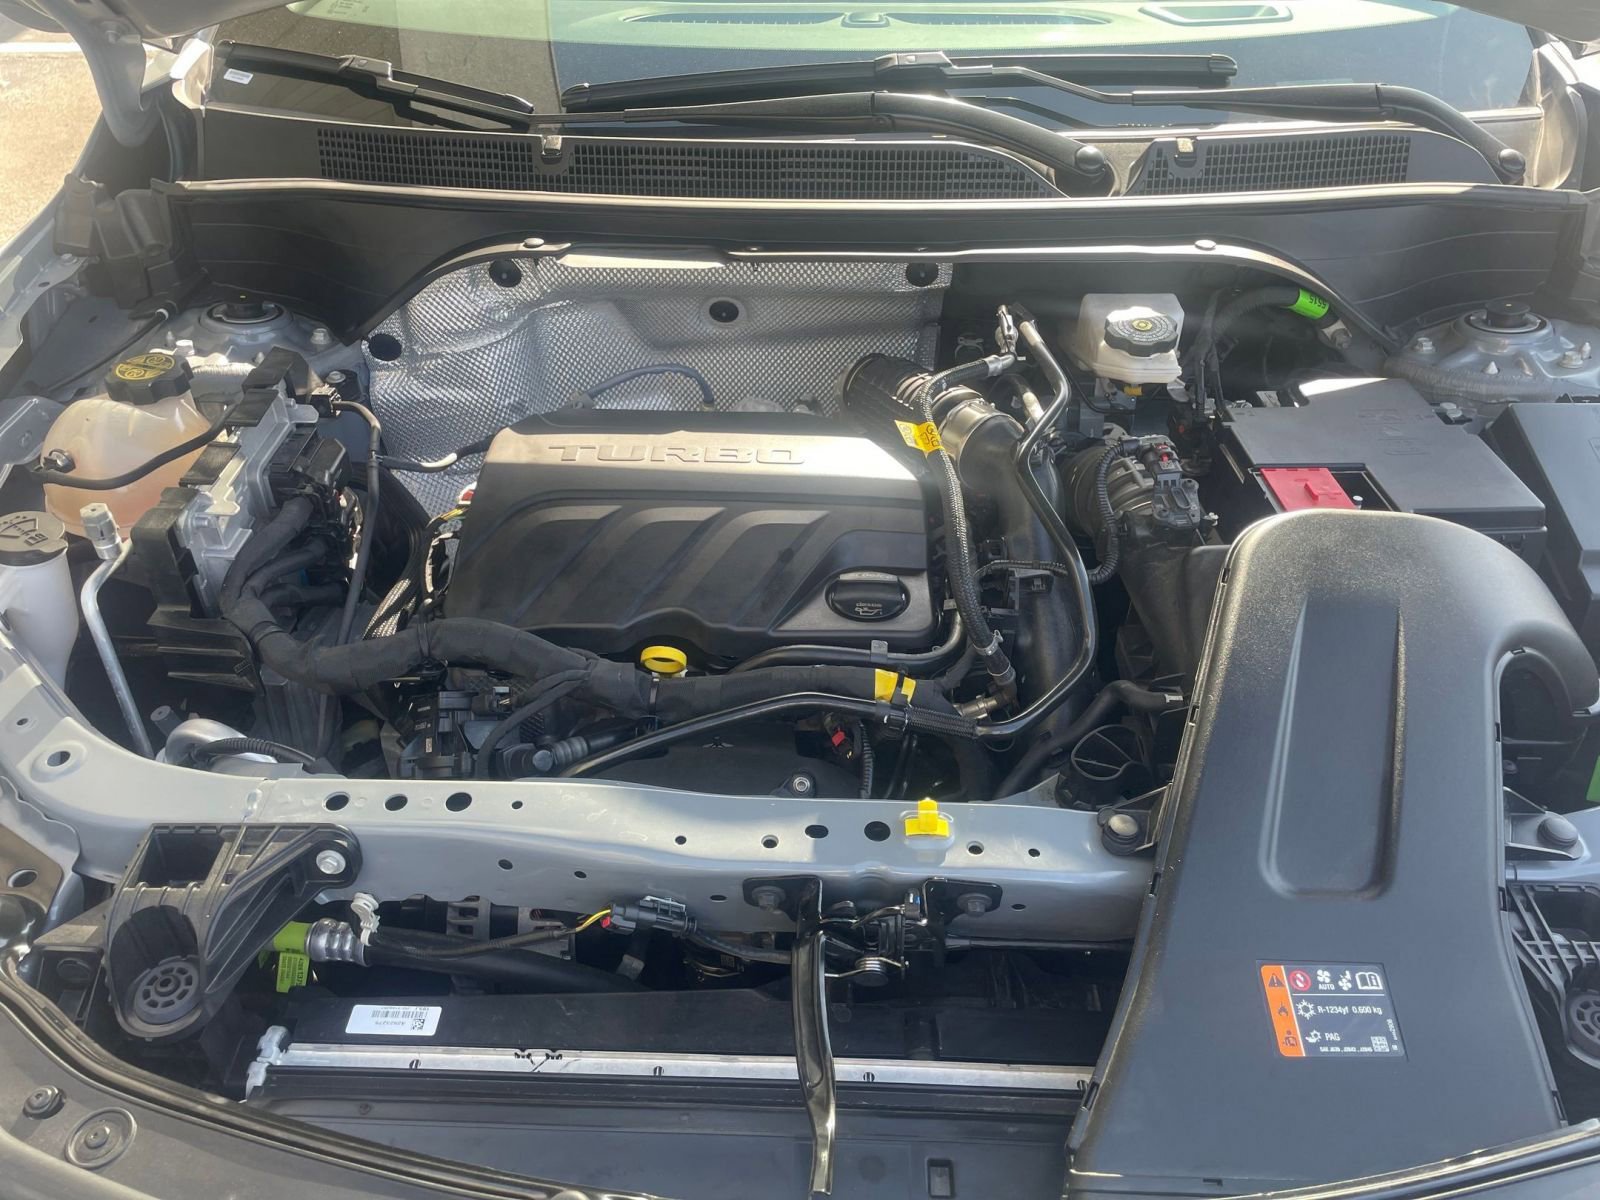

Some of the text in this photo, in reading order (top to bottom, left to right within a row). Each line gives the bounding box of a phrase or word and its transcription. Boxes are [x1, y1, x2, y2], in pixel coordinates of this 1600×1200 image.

[548, 445, 804, 464] TURBO
[1318, 983, 1335, 991] AUTO
[1317, 1005, 1383, 1015] R-1234yf 0.600 kg
[1324, 1032, 1341, 1041] PAG
